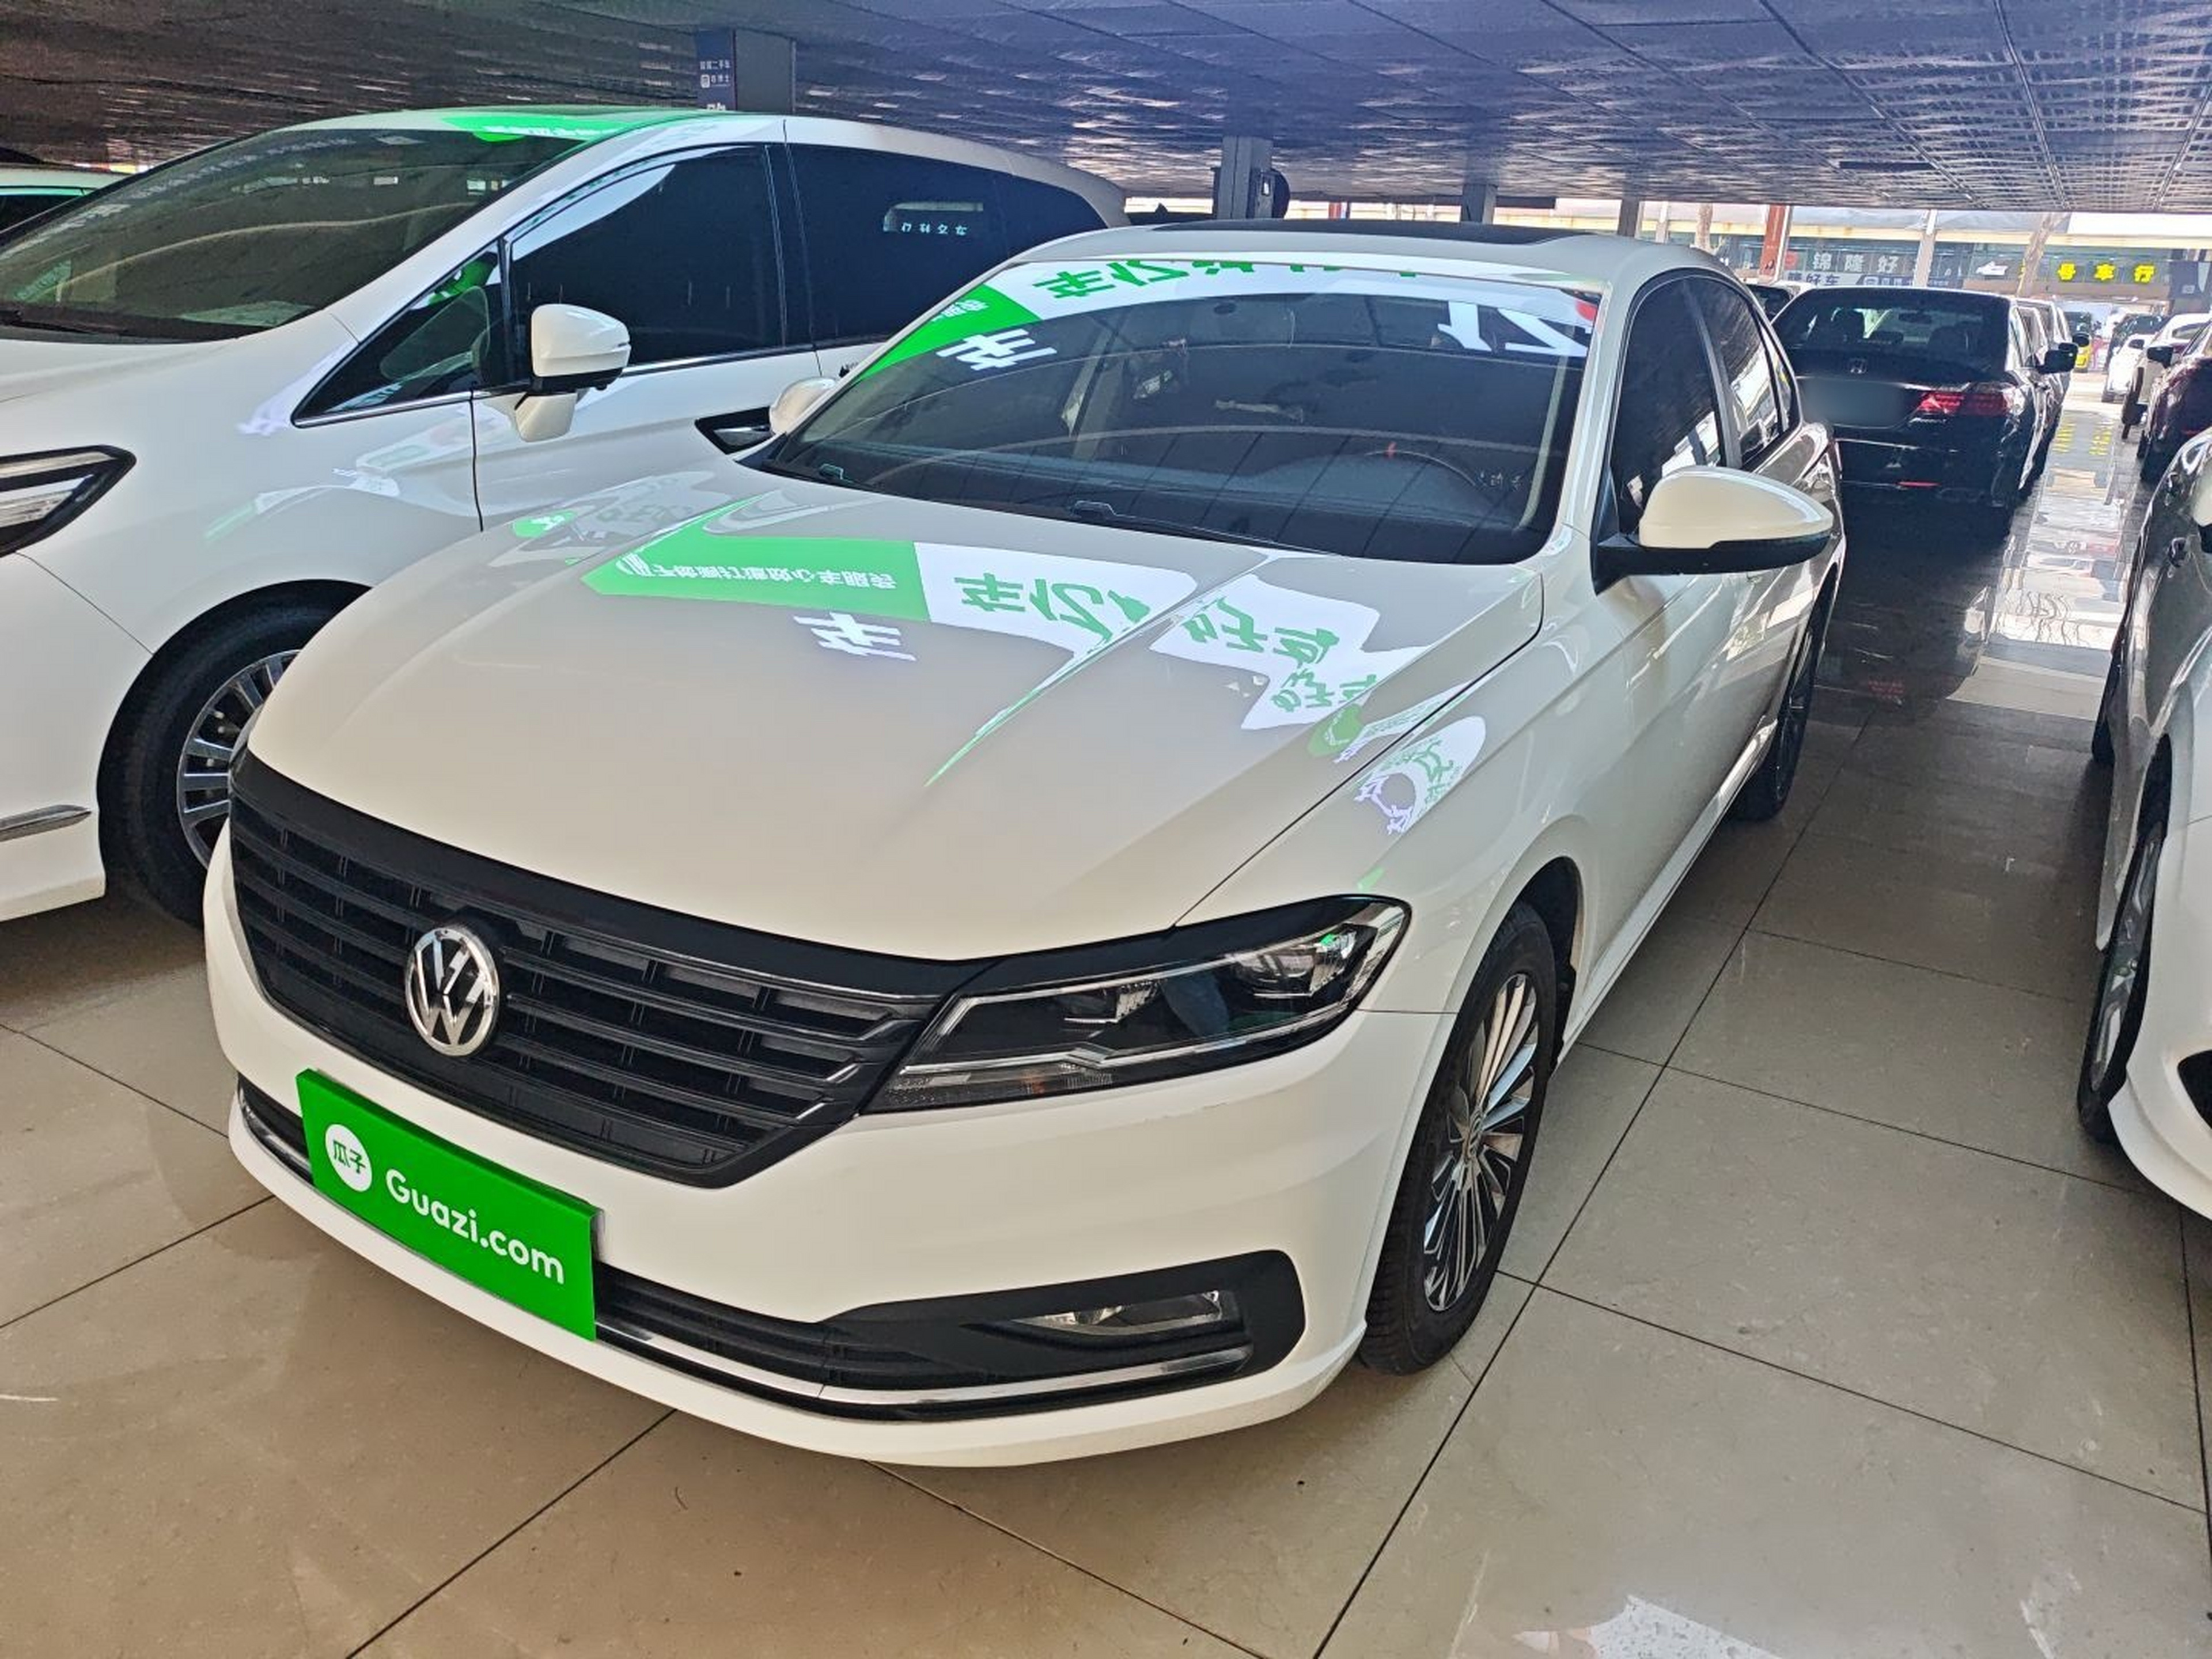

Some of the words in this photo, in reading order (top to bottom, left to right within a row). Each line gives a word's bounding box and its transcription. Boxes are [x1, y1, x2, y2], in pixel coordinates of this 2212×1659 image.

[1813, 252, 1917, 274] 锦隆好
[332, 1139, 366, 1175] 瓜子
[385, 1169, 564, 1285] Guazi.com
